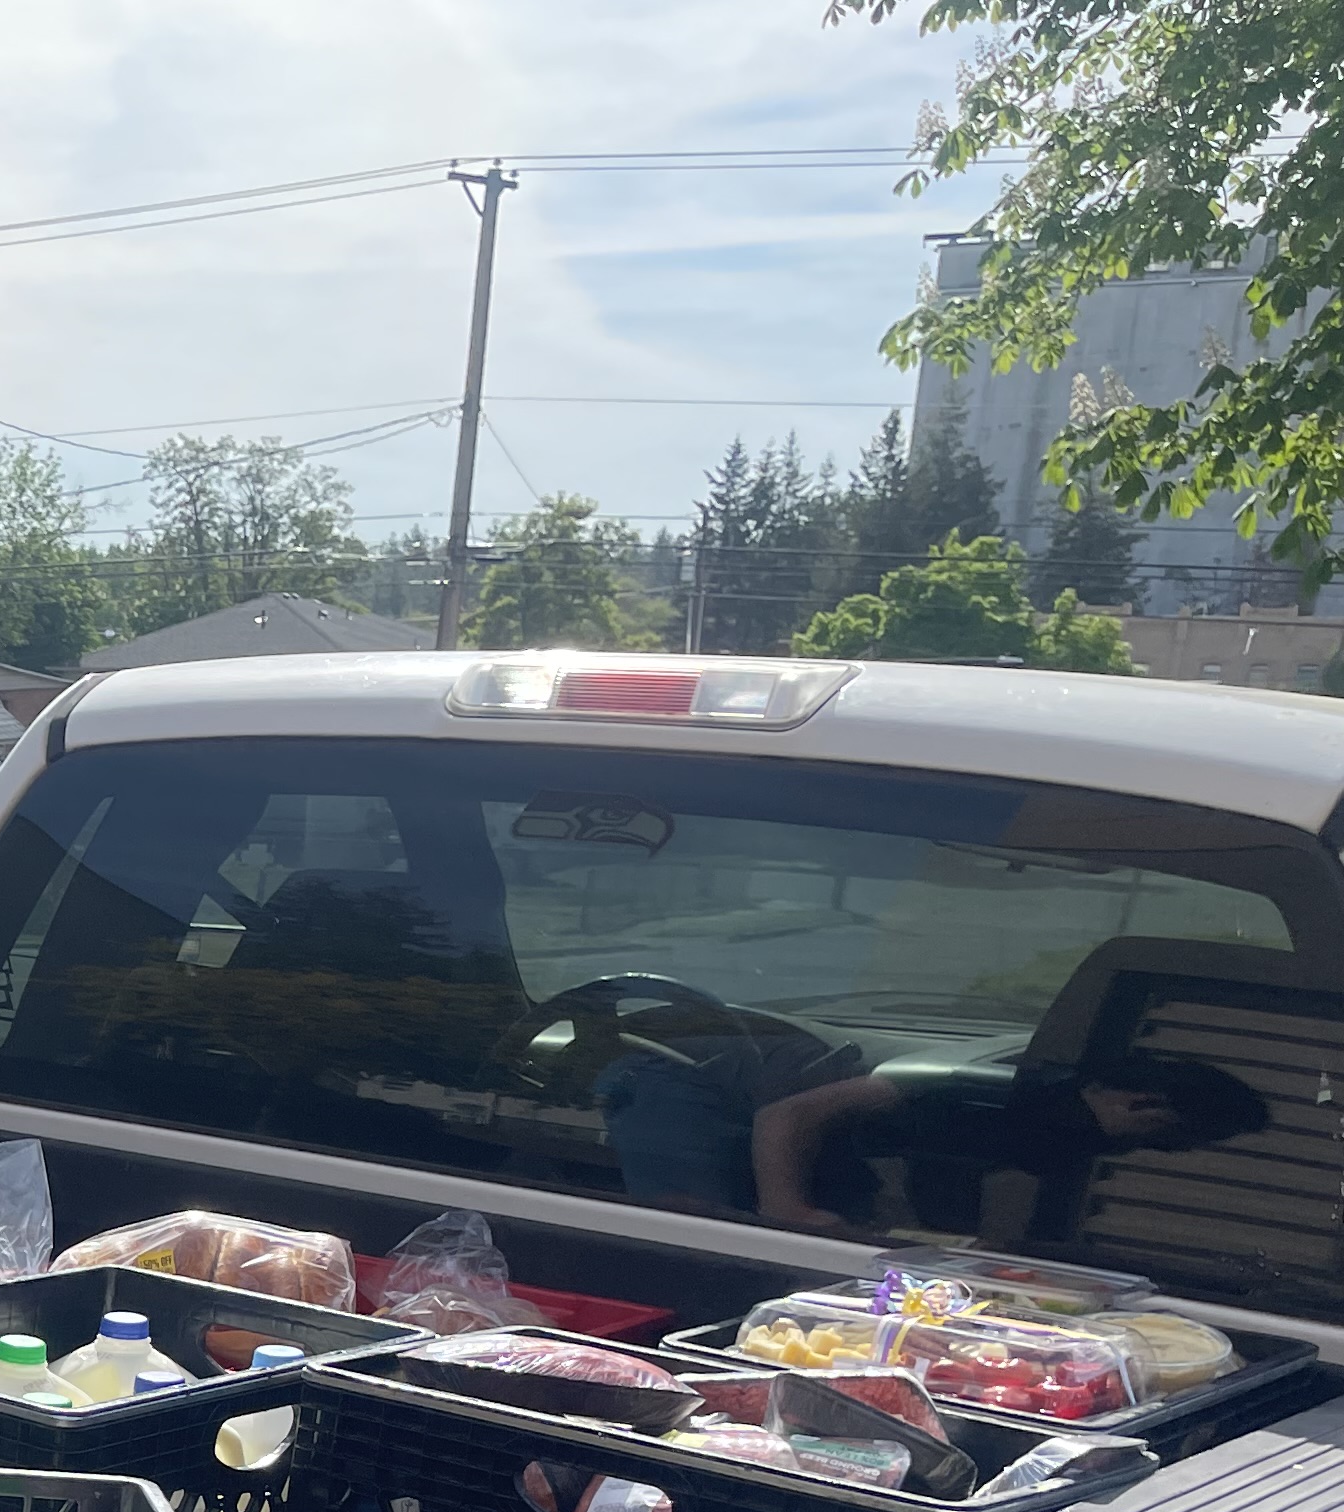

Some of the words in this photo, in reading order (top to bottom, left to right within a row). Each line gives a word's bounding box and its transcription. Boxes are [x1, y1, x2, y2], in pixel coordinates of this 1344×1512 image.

[161, 1255, 172, 1267] OFF
[799, 1452, 829, 1464] BEEF
[830, 1459, 881, 1476] GROUND
